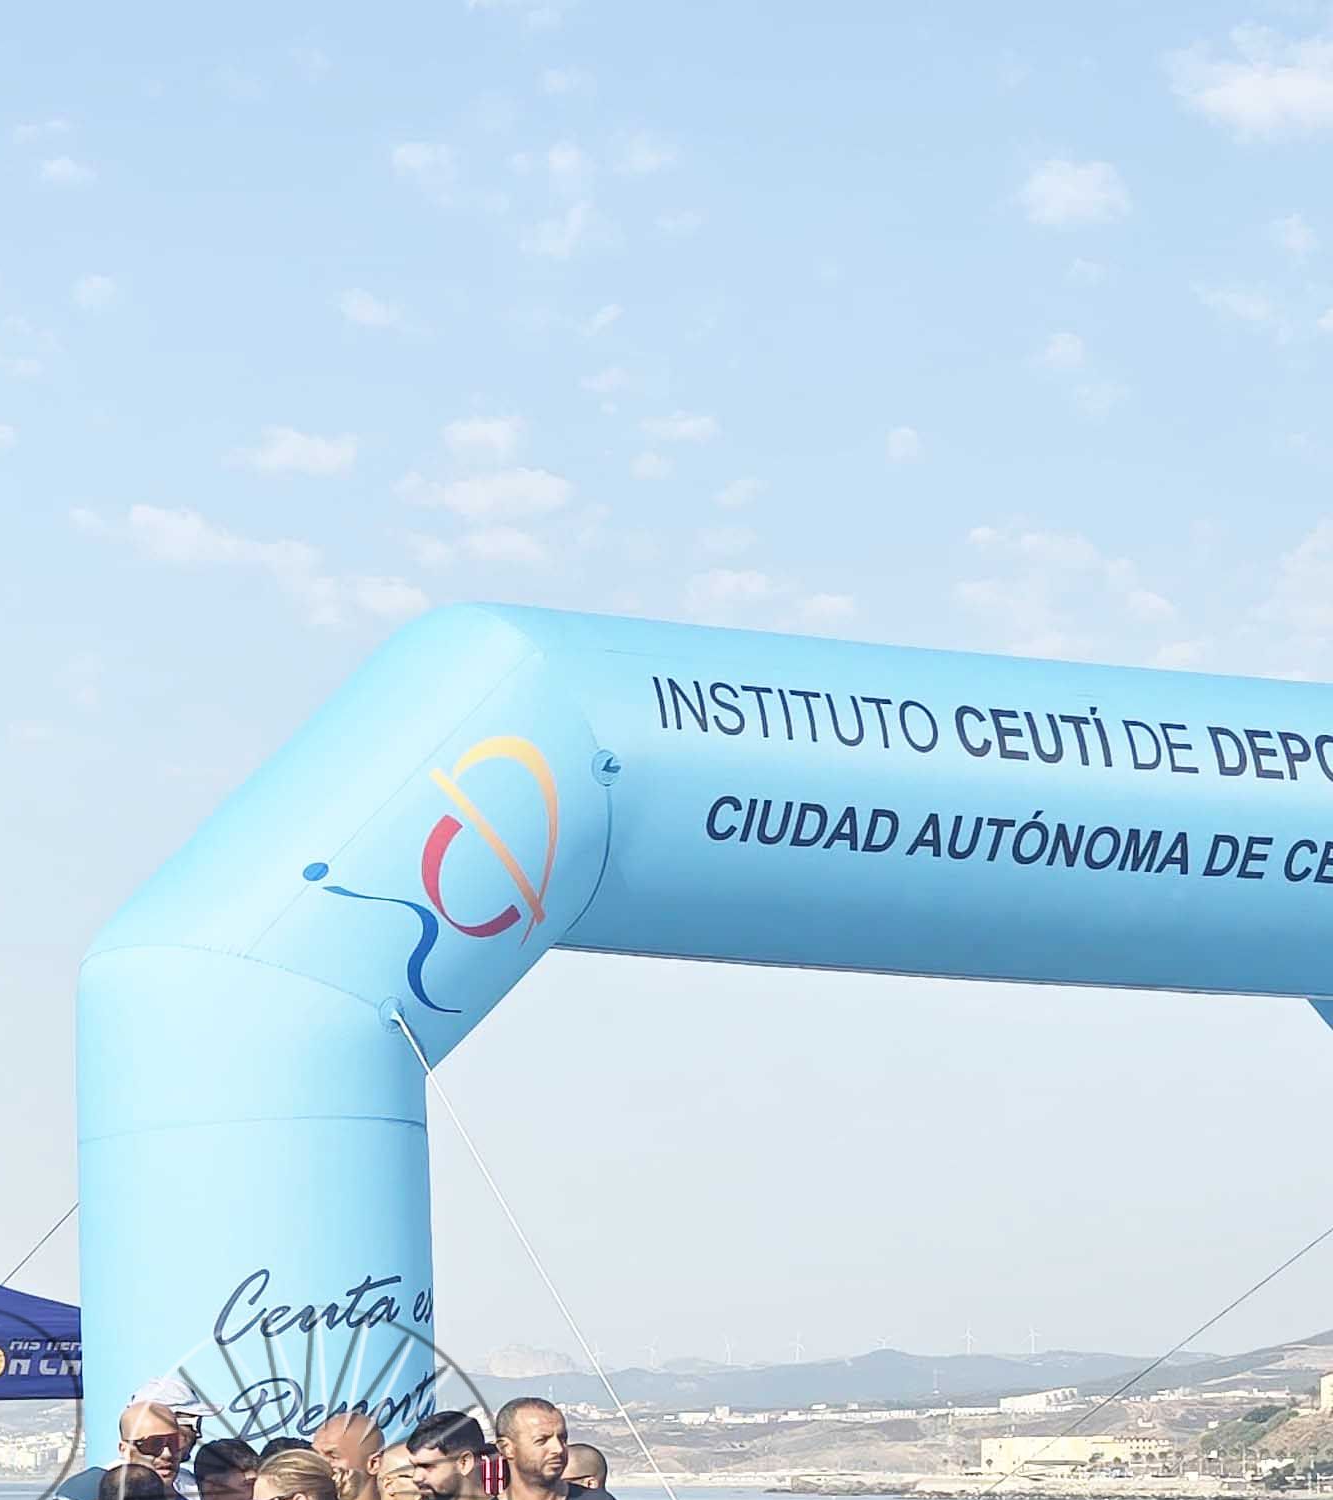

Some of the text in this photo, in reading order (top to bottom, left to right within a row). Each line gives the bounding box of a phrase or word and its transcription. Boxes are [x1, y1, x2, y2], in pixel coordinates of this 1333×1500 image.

[652, 676, 936, 753] INSTITUTO
[953, 706, 1114, 768] CEUTÍ
[1122, 719, 1199, 774] DE
[706, 795, 1333, 884] CIUDAD AUTÓNOMA DE CE
